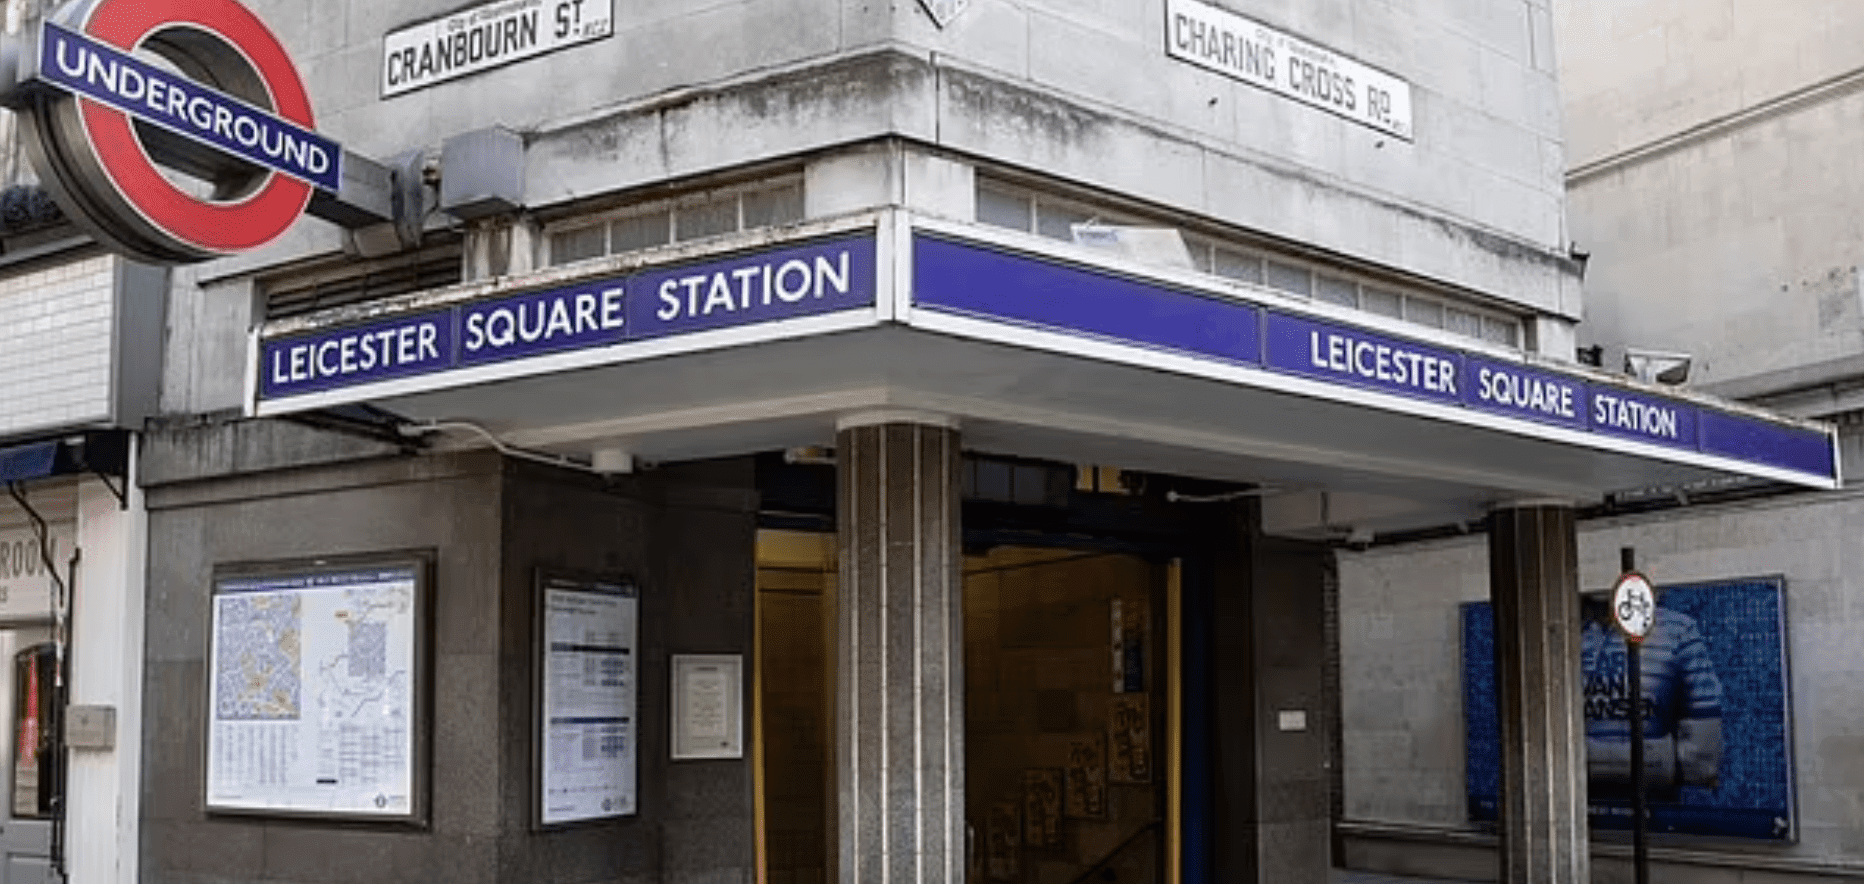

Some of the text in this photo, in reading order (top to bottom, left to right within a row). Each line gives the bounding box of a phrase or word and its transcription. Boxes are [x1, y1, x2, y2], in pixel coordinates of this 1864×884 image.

[387, 9, 538, 87] CRANBOURN
[1175, 12, 1276, 81] CHARING
[1288, 55, 1356, 111] CROSS
[55, 38, 331, 175] UNDERGROUND
[272, 250, 852, 386] LEICESTER SQUARE STATION
[1310, 330, 1677, 439] LEICESTER SQUARE STATION
[1580, 650, 1626, 674] EAR
[1581, 673, 1627, 699] VAN
